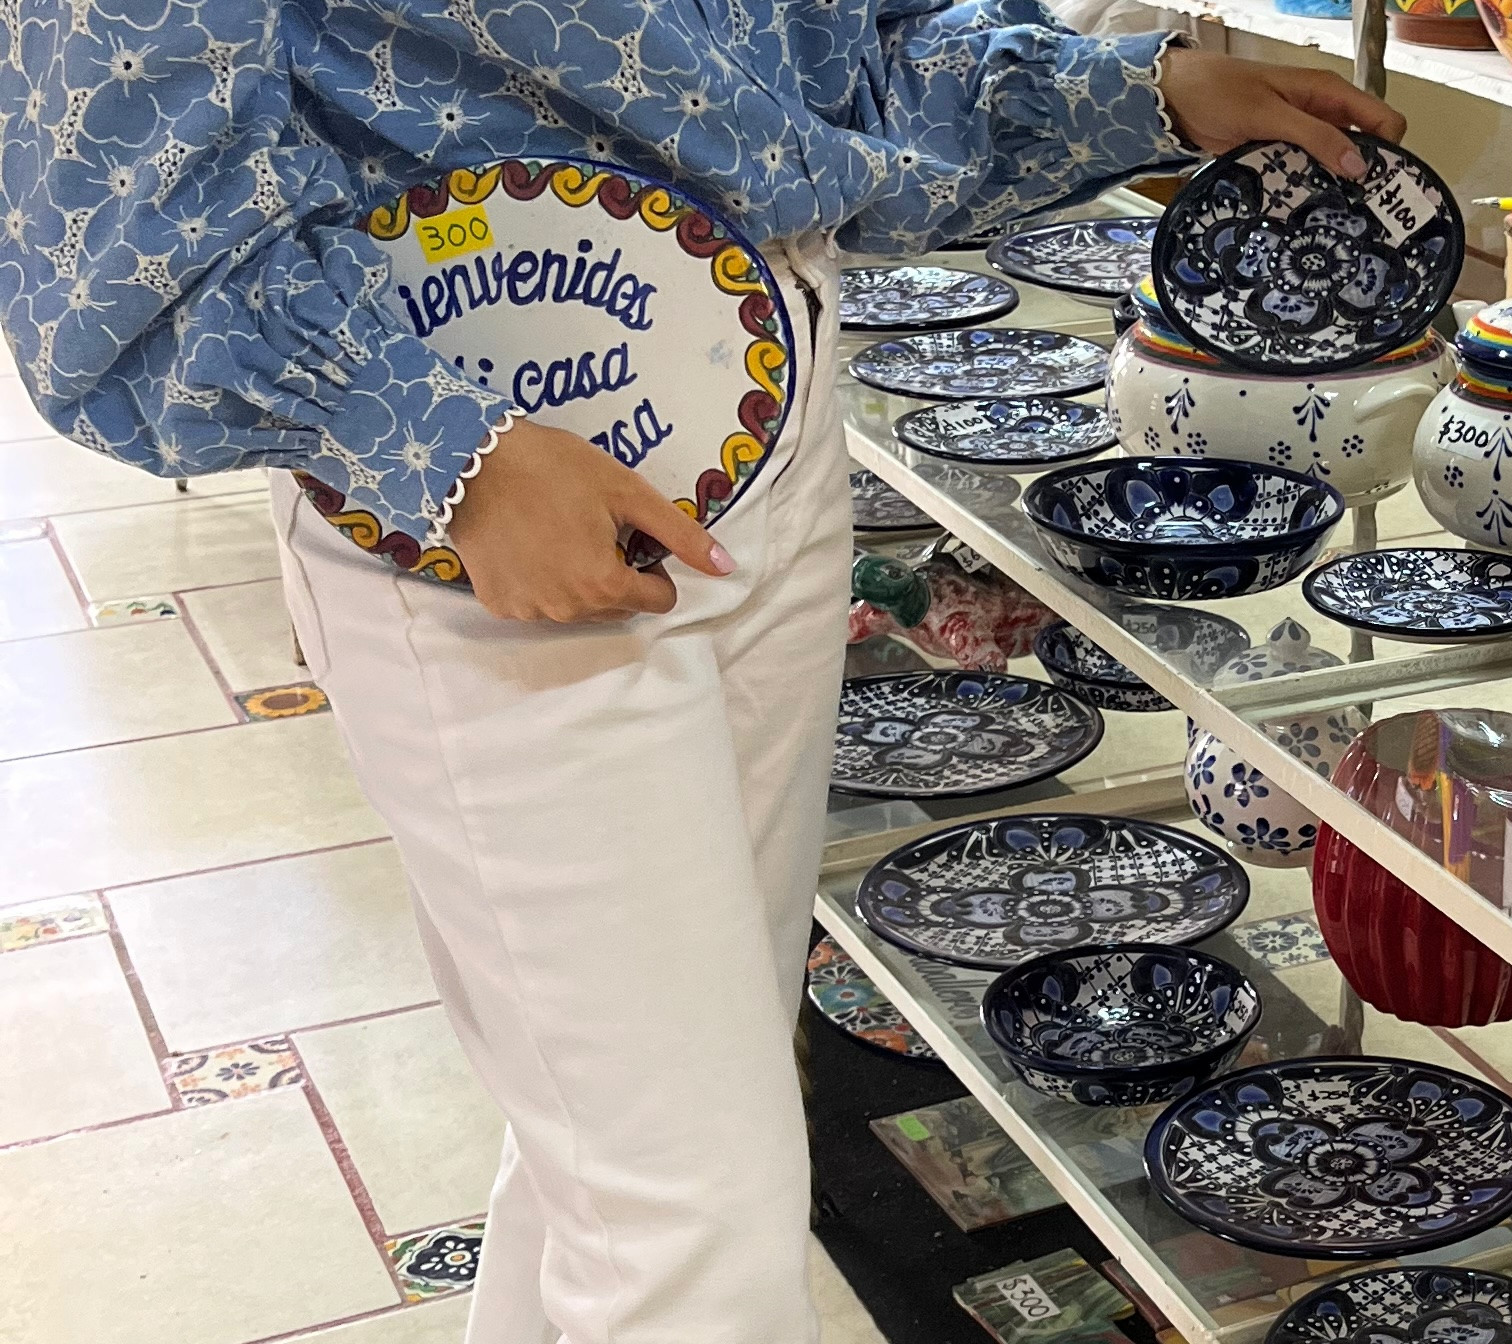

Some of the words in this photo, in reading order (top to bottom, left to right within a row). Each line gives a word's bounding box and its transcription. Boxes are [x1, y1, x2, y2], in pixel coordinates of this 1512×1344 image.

[1379, 183, 1416, 231] $100
[422, 217, 488, 250] 300
[398, 239, 658, 338] ienvenidos
[513, 342, 638, 413] casa
[1438, 415, 1489, 448] $300
[1002, 1278, 1050, 1317] $300
